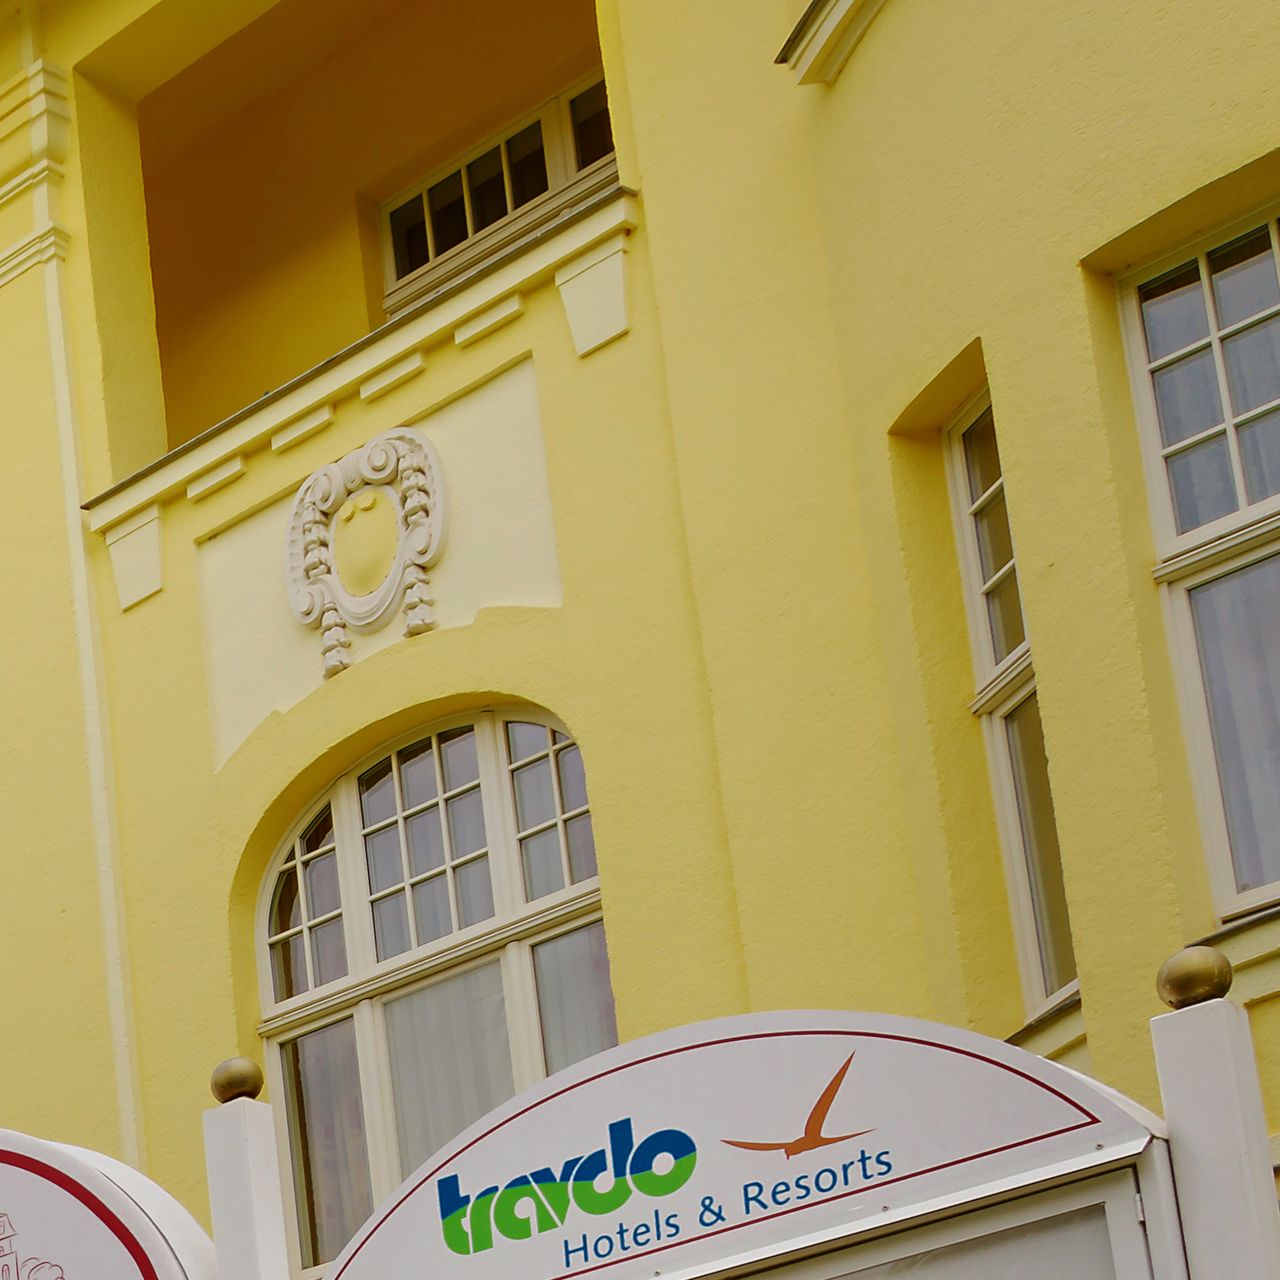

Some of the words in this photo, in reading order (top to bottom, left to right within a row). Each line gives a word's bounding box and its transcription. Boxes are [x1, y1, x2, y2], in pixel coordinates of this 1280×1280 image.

[437, 1117, 699, 1256] travdo
[563, 1208, 681, 1268] Hotels
[697, 1193, 727, 1228] &
[741, 1148, 894, 1214] Resorts
